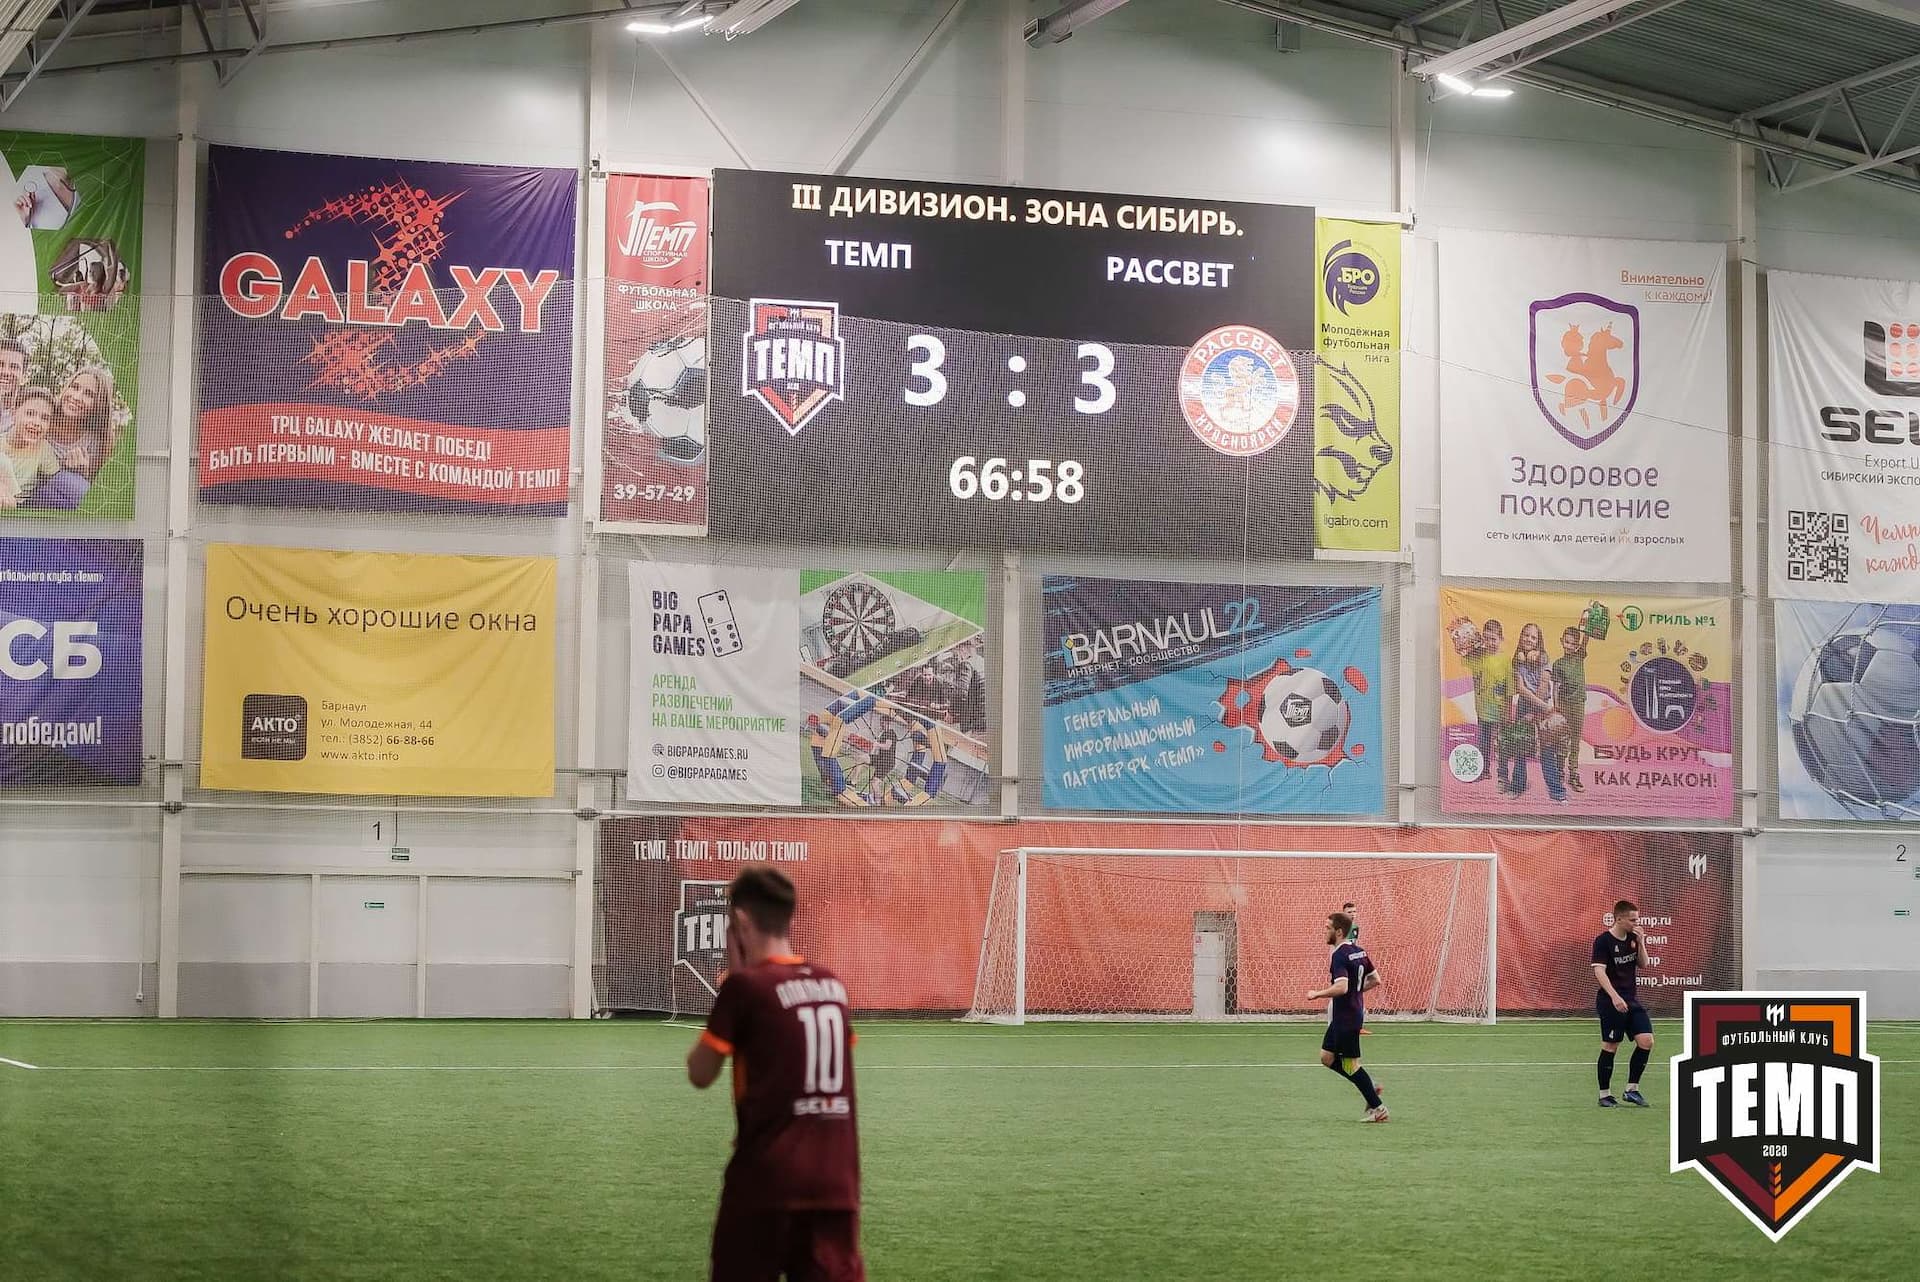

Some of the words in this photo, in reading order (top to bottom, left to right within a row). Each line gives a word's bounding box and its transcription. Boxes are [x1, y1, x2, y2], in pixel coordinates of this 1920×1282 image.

[792, 184, 822, 212] III
[829, 186, 1017, 223] ДИВИЗИОН.
[1025, 199, 1109, 229] ЗОНА
[1116, 205, 1245, 238] СИБИРЬ.
[825, 239, 914, 270] ТЕМП
[1107, 256, 1235, 289] РАССВЕТ
[1620, 270, 1705, 286] Внимательно
[218, 251, 560, 333] GALAXY
[618, 284, 698, 298] ФУТБОЛЬНАЯ
[1645, 291, 1651, 300] к
[635, 299, 678, 311] ШКОЛА
[1193, 331, 1287, 370] РАССВЕТ
[1323, 336, 1391, 351] футбольная
[753, 338, 835, 386] ТЕМП
[1365, 354, 1390, 364] лига
[903, 334, 948, 408] 3
[1073, 342, 1117, 415] 3
[271, 415, 301, 437] ТРЦ
[305, 416, 364, 442] GALAXY
[368, 424, 431, 452] ЖЕЛАЕТ
[435, 435, 492, 462] ПОБЕД!
[210, 446, 252, 471] БЫТЬ
[257, 443, 335, 466] ПЕРВЫМИ
[352, 450, 410, 477] ВМЕСТЕ
[415, 460, 424, 479] С
[429, 462, 514, 490] КОМАНДОЙ
[518, 468, 562, 489] ТЕМП!
[1511, 456, 1659, 489] Здоровое
[1865, 454, 1907, 472] Export
[949, 456, 1086, 504] 66:58
[1820, 470, 1884, 485] СИБИРСКИЙ
[613, 483, 696, 502] 39-57-29
[1500, 494, 1671, 520] поколение
[1324, 513, 1389, 529] ligabro.com
[1486, 530, 1509, 541] сеть
[1512, 531, 1551, 542] клиник
[1553, 533, 1573, 544] для
[1575, 532, 1607, 544] детей
[1609, 536, 1616, 544] и
[1634, 535, 1685, 547] взрослых
[46, 569, 72, 584] клуба
[653, 590, 678, 611] BIG
[225, 595, 318, 625] Очень
[328, 606, 460, 633] хорошие
[469, 610, 538, 632] окна
[653, 612, 693, 635] PAPA
[1649, 613, 1691, 627] ГРИЛЬ
[653, 635, 706, 657] GAMES
[1067, 660, 1121, 679] ИНТЕРНЕТ
[1129, 644, 1201, 667] СООБЩЕСТВО
[652, 673, 697, 691] АРЕНДА
[322, 700, 368, 713] Барнаул
[652, 693, 734, 713] РАЗВЛЕЧЕНИЙ
[321, 719, 336, 730] ул.
[419, 719, 433, 729] 44
[652, 712, 668, 728] НА
[671, 713, 703, 729] ВАШЕ
[706, 715, 787, 733] МЕРОПРИЯТИЕ
[1064, 695, 1161, 733] ГЕНЕРАЛЬНЫЙ
[2, 716, 102, 748] победам!
[349, 734, 384, 747] (3852)
[386, 736, 435, 746] 66-88-66
[1064, 715, 1196, 763] ИНФОРМАЦИОННЫЙ
[321, 750, 400, 762] www.akto.info
[667, 744, 749, 761] BIGPAPAGAMES.RU
[1594, 744, 1652, 763] БУДЬ
[1656, 746, 1707, 765] КРУТ,
[667, 765, 749, 781] @BIGPAPAGAMES
[1063, 761, 1124, 790] ПАРТНЕР
[1128, 755, 1152, 775] ФК
[1154, 745, 1205, 769] «ТЕМП»
[1594, 770, 1631, 786] КАК
[1636, 770, 1718, 790] ДРАКОН!
[372, 820, 381, 841] 1
[633, 840, 671, 862] ТЕМП,
[716, 840, 767, 861] ТОЛЬКО
[770, 841, 808, 862] ТЕМП!
[1896, 843, 1907, 862] 2
[797, 1004, 844, 1094] 10
